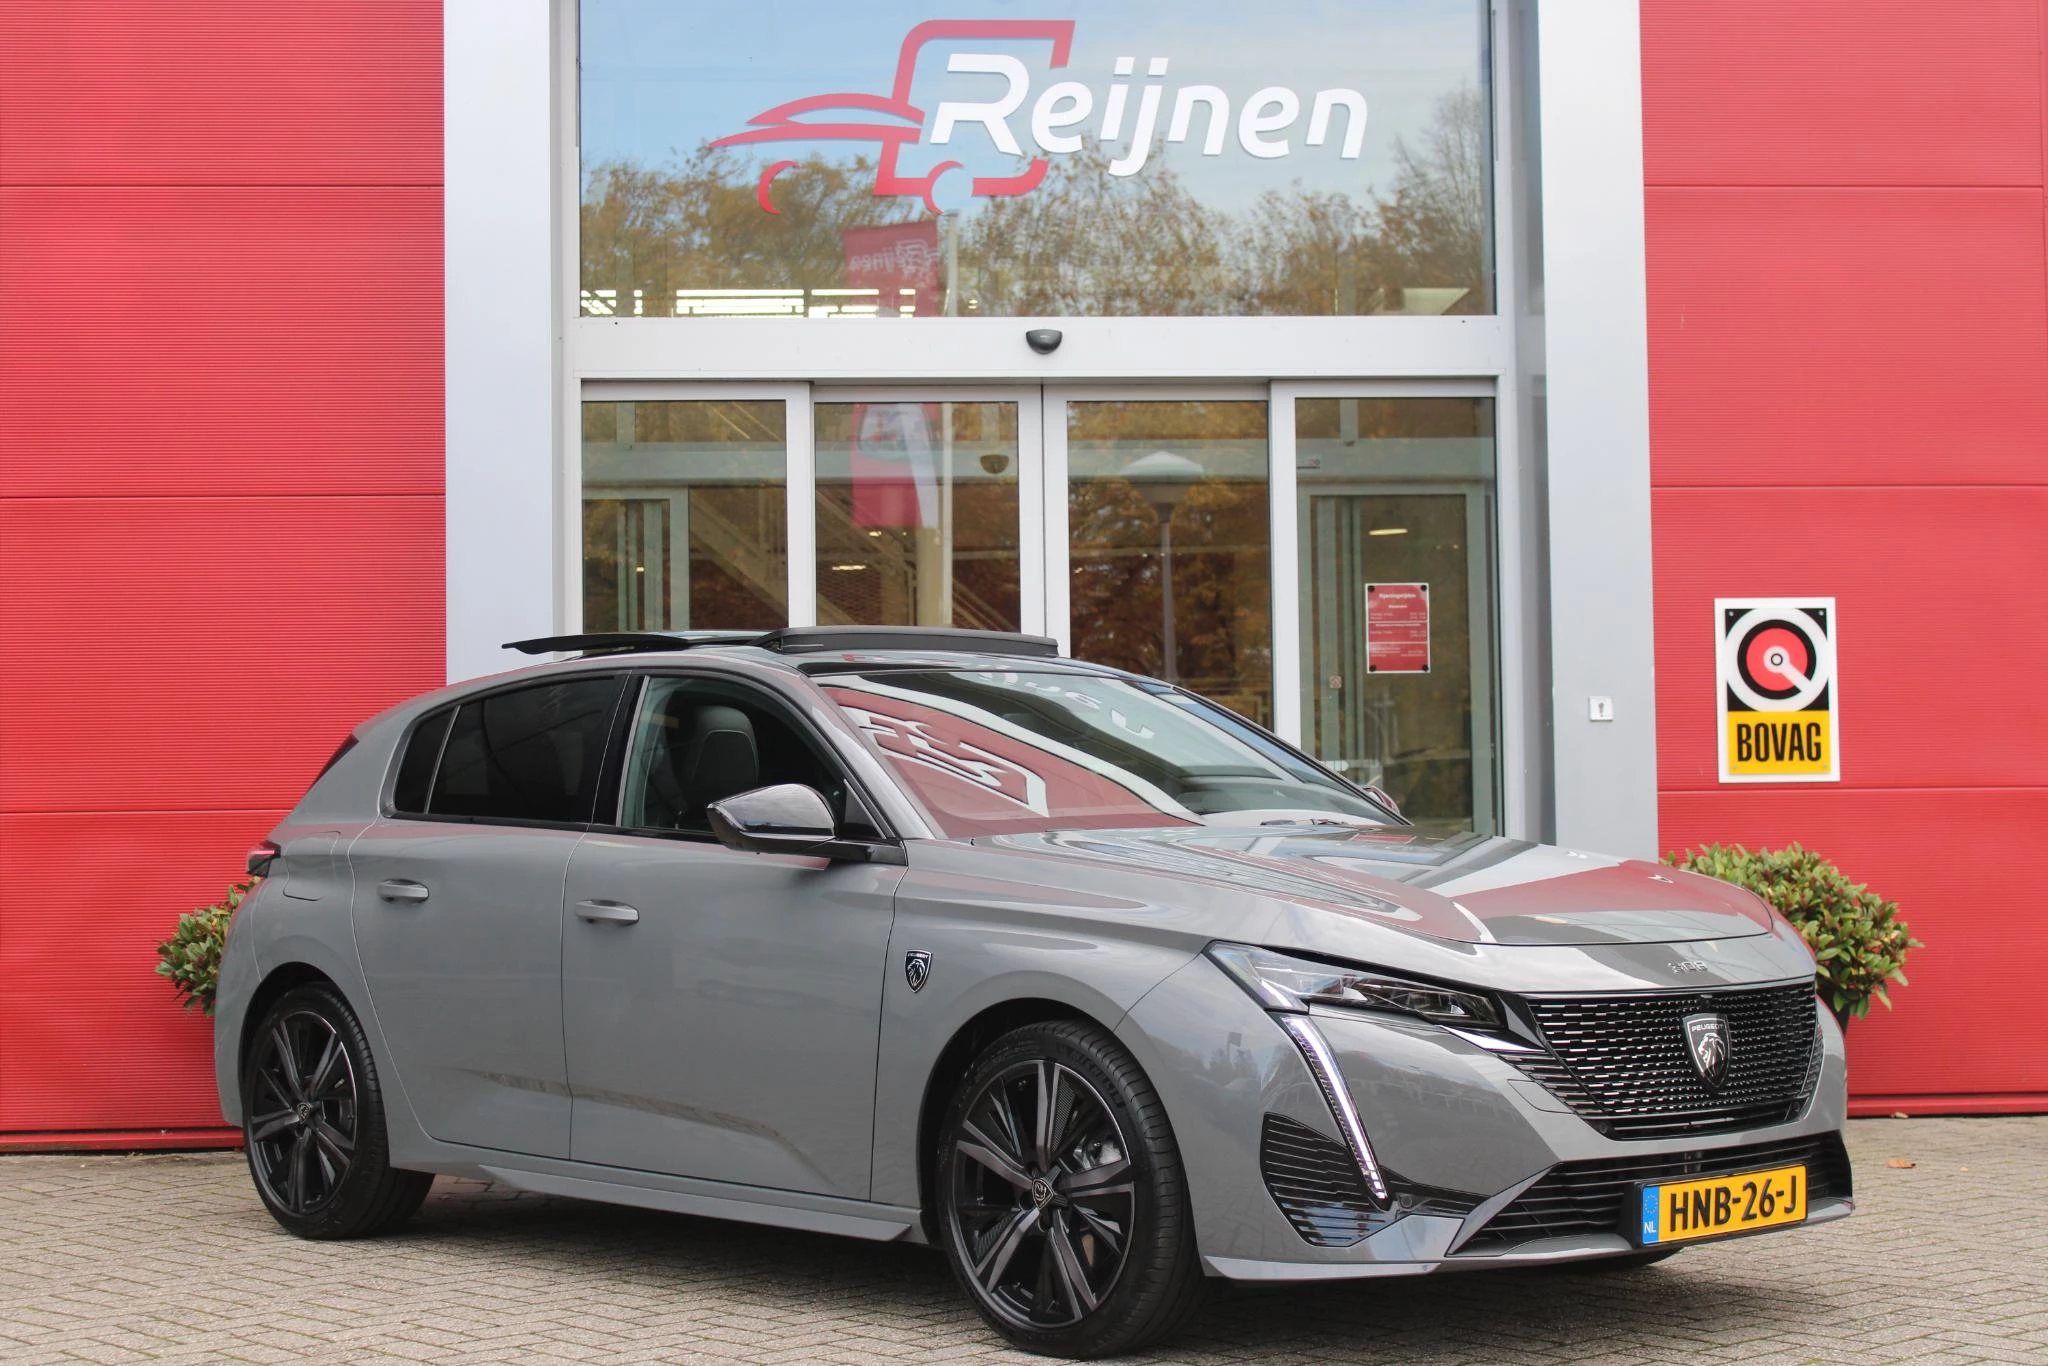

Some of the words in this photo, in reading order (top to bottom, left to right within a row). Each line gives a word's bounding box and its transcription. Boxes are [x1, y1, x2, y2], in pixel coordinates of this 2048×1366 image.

[929, 53, 1368, 178] Reijnen
[1736, 722, 1822, 762] BOVAG
[1691, 1023, 1724, 1032] PEUGEOT
[1644, 1221, 1657, 1234] NL
[1669, 1175, 1797, 1233] HNB-26-J
